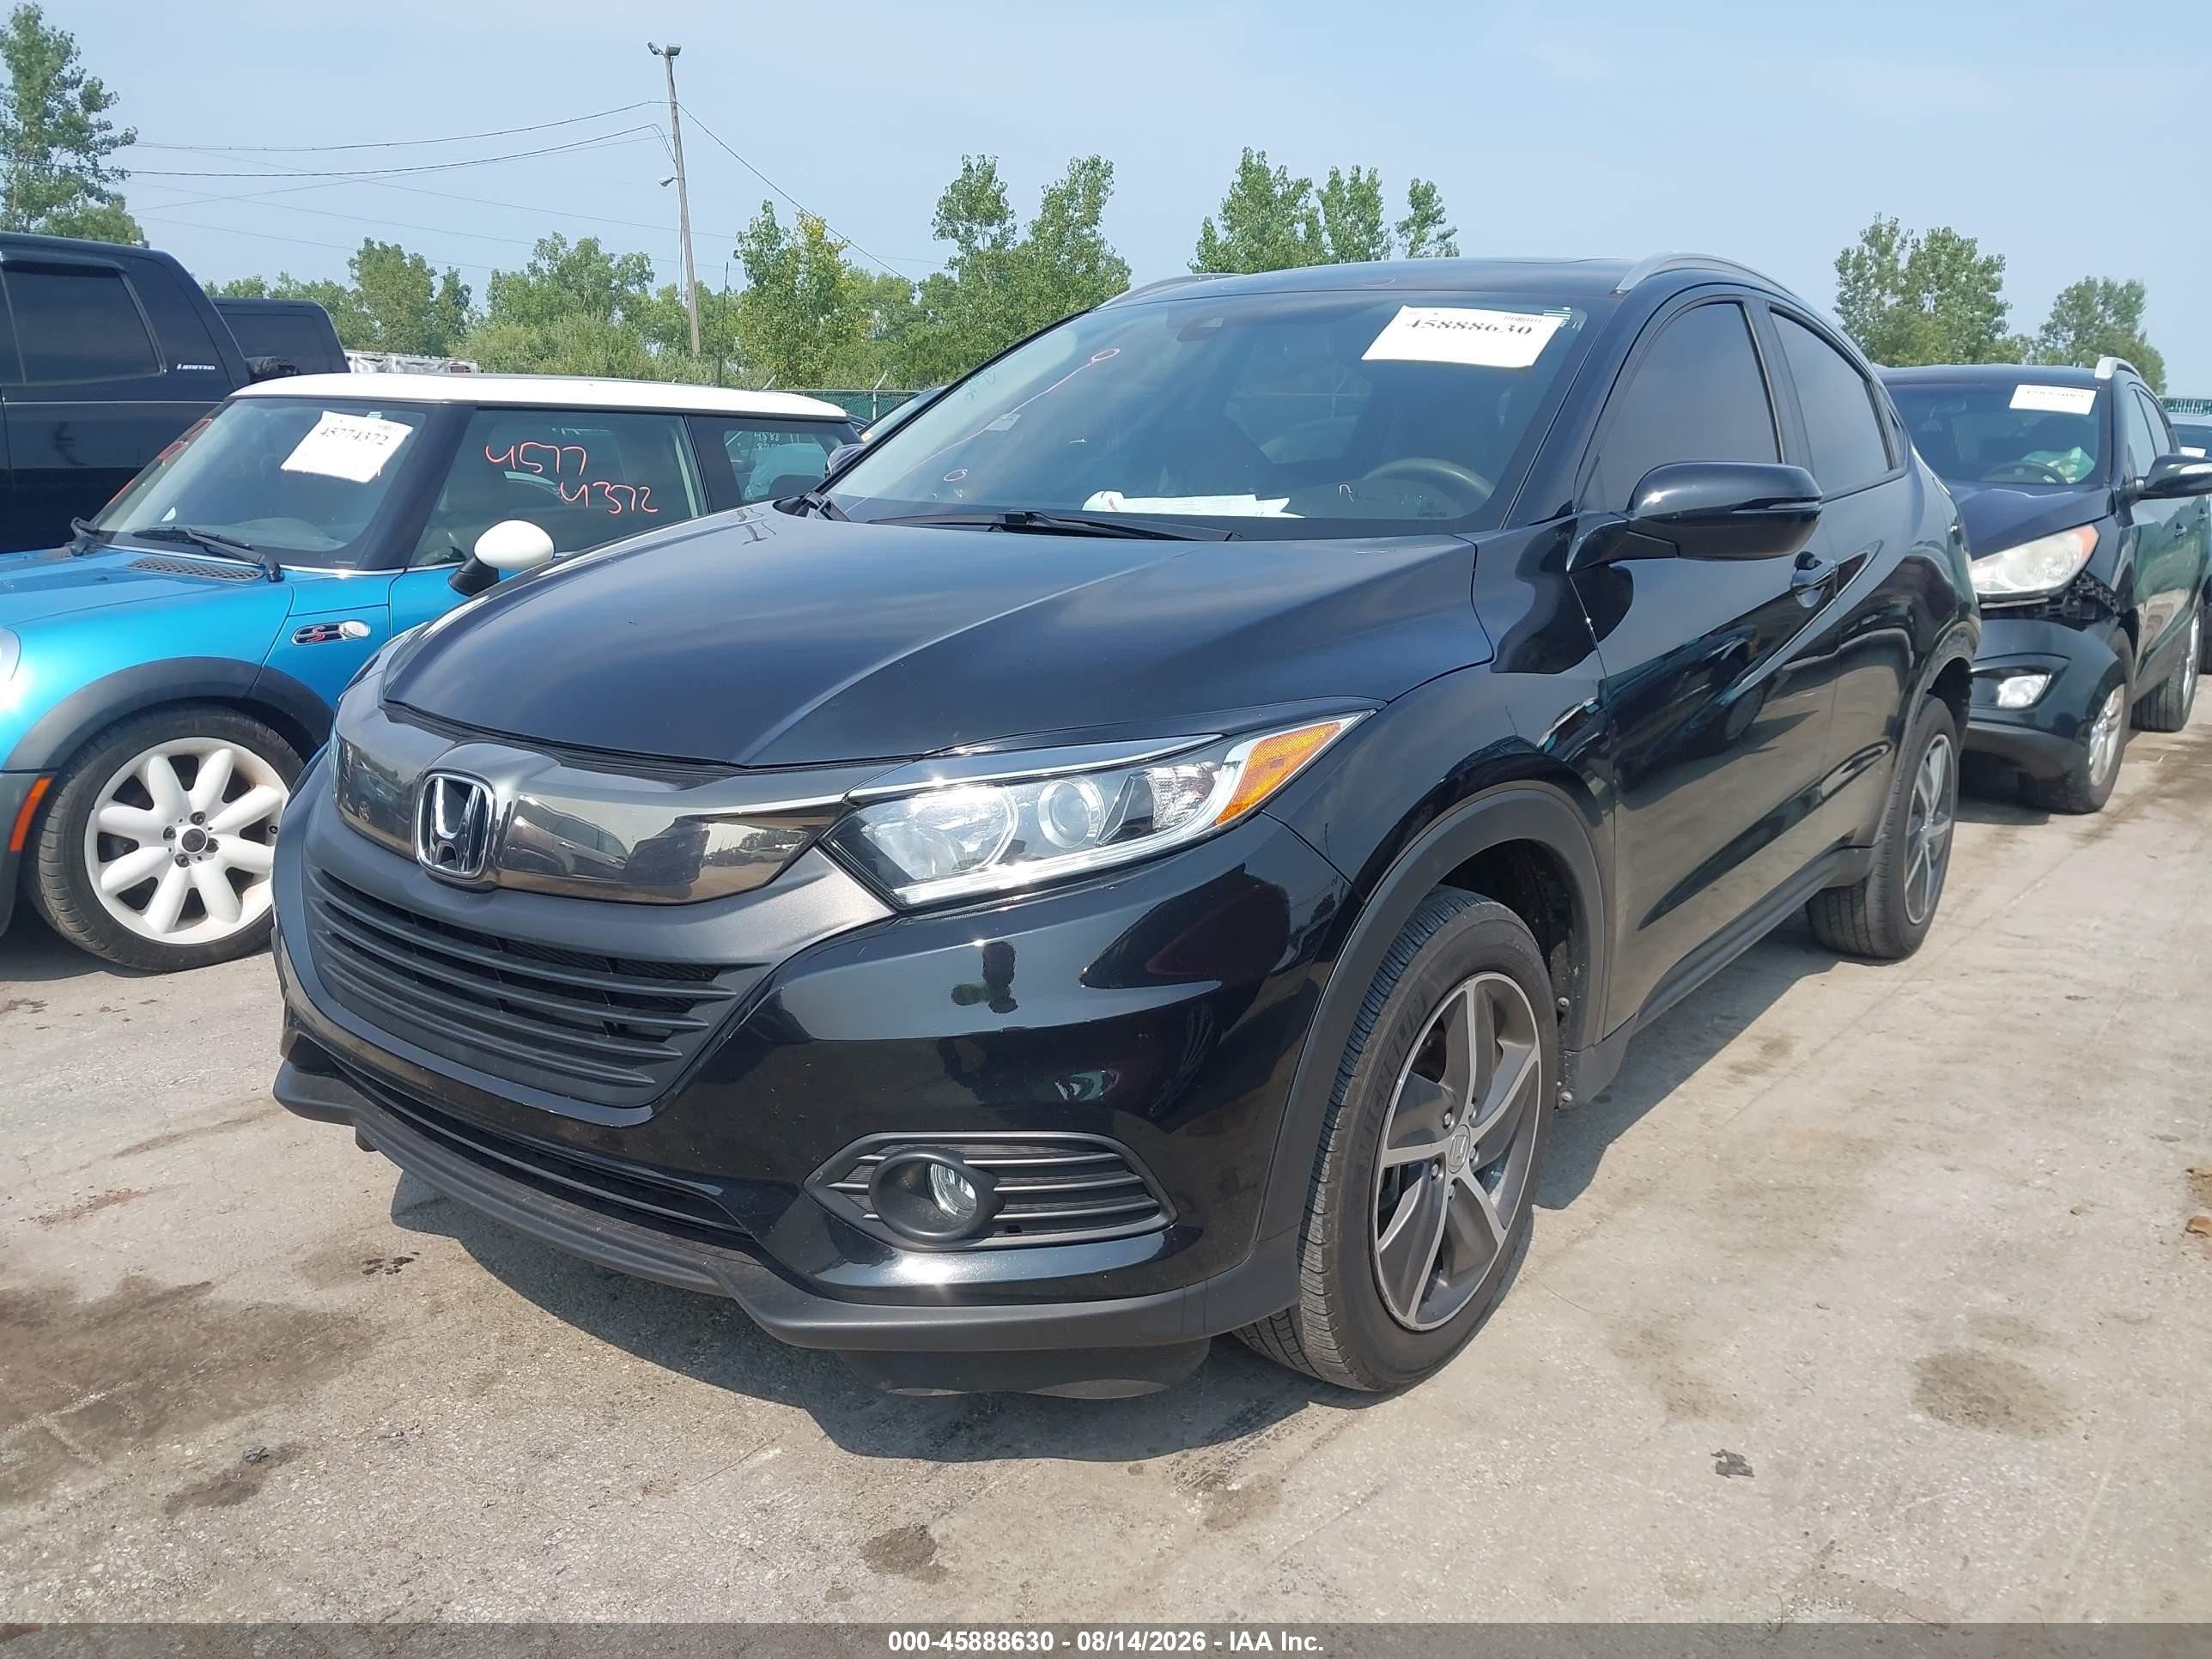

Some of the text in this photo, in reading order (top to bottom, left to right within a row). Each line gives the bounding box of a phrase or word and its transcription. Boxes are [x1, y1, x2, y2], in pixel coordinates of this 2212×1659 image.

[1406, 319, 1533, 336] 45888630
[319, 426, 389, 446] 45774372
[484, 441, 587, 477] 4577
[560, 480, 659, 514] 4372
